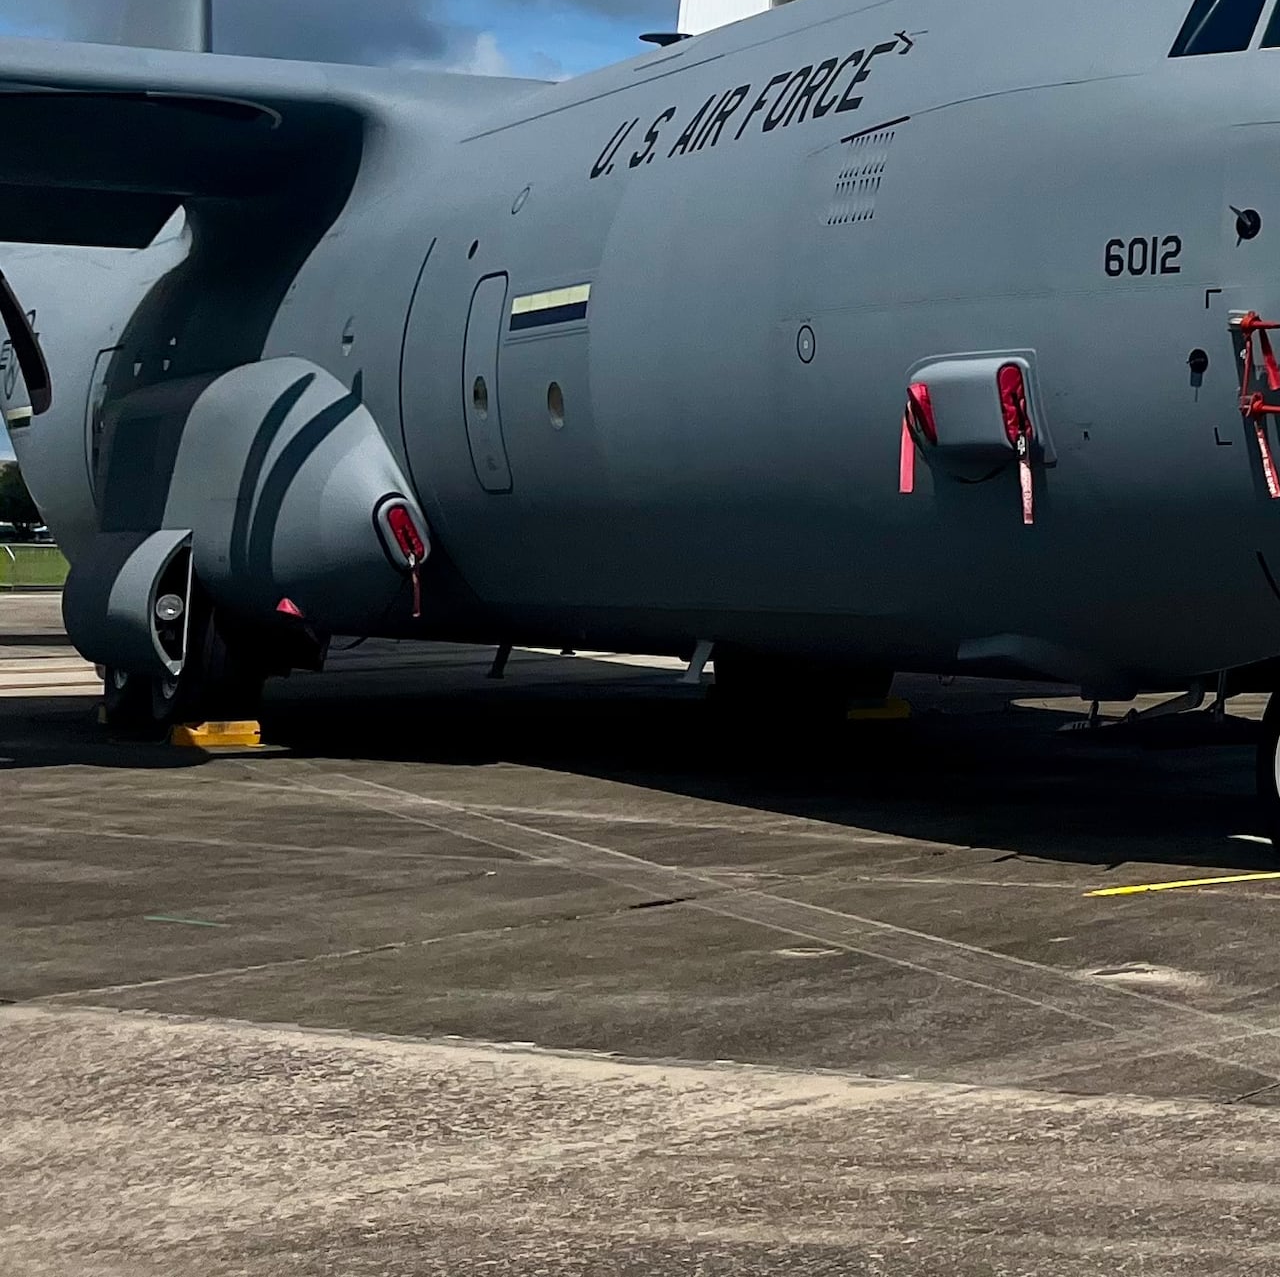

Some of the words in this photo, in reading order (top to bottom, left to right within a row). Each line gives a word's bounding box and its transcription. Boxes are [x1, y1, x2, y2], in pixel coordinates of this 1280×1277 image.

[667, 82, 752, 158] AIR
[734, 39, 899, 141] FORCE
[1104, 234, 1182, 277] 6012
